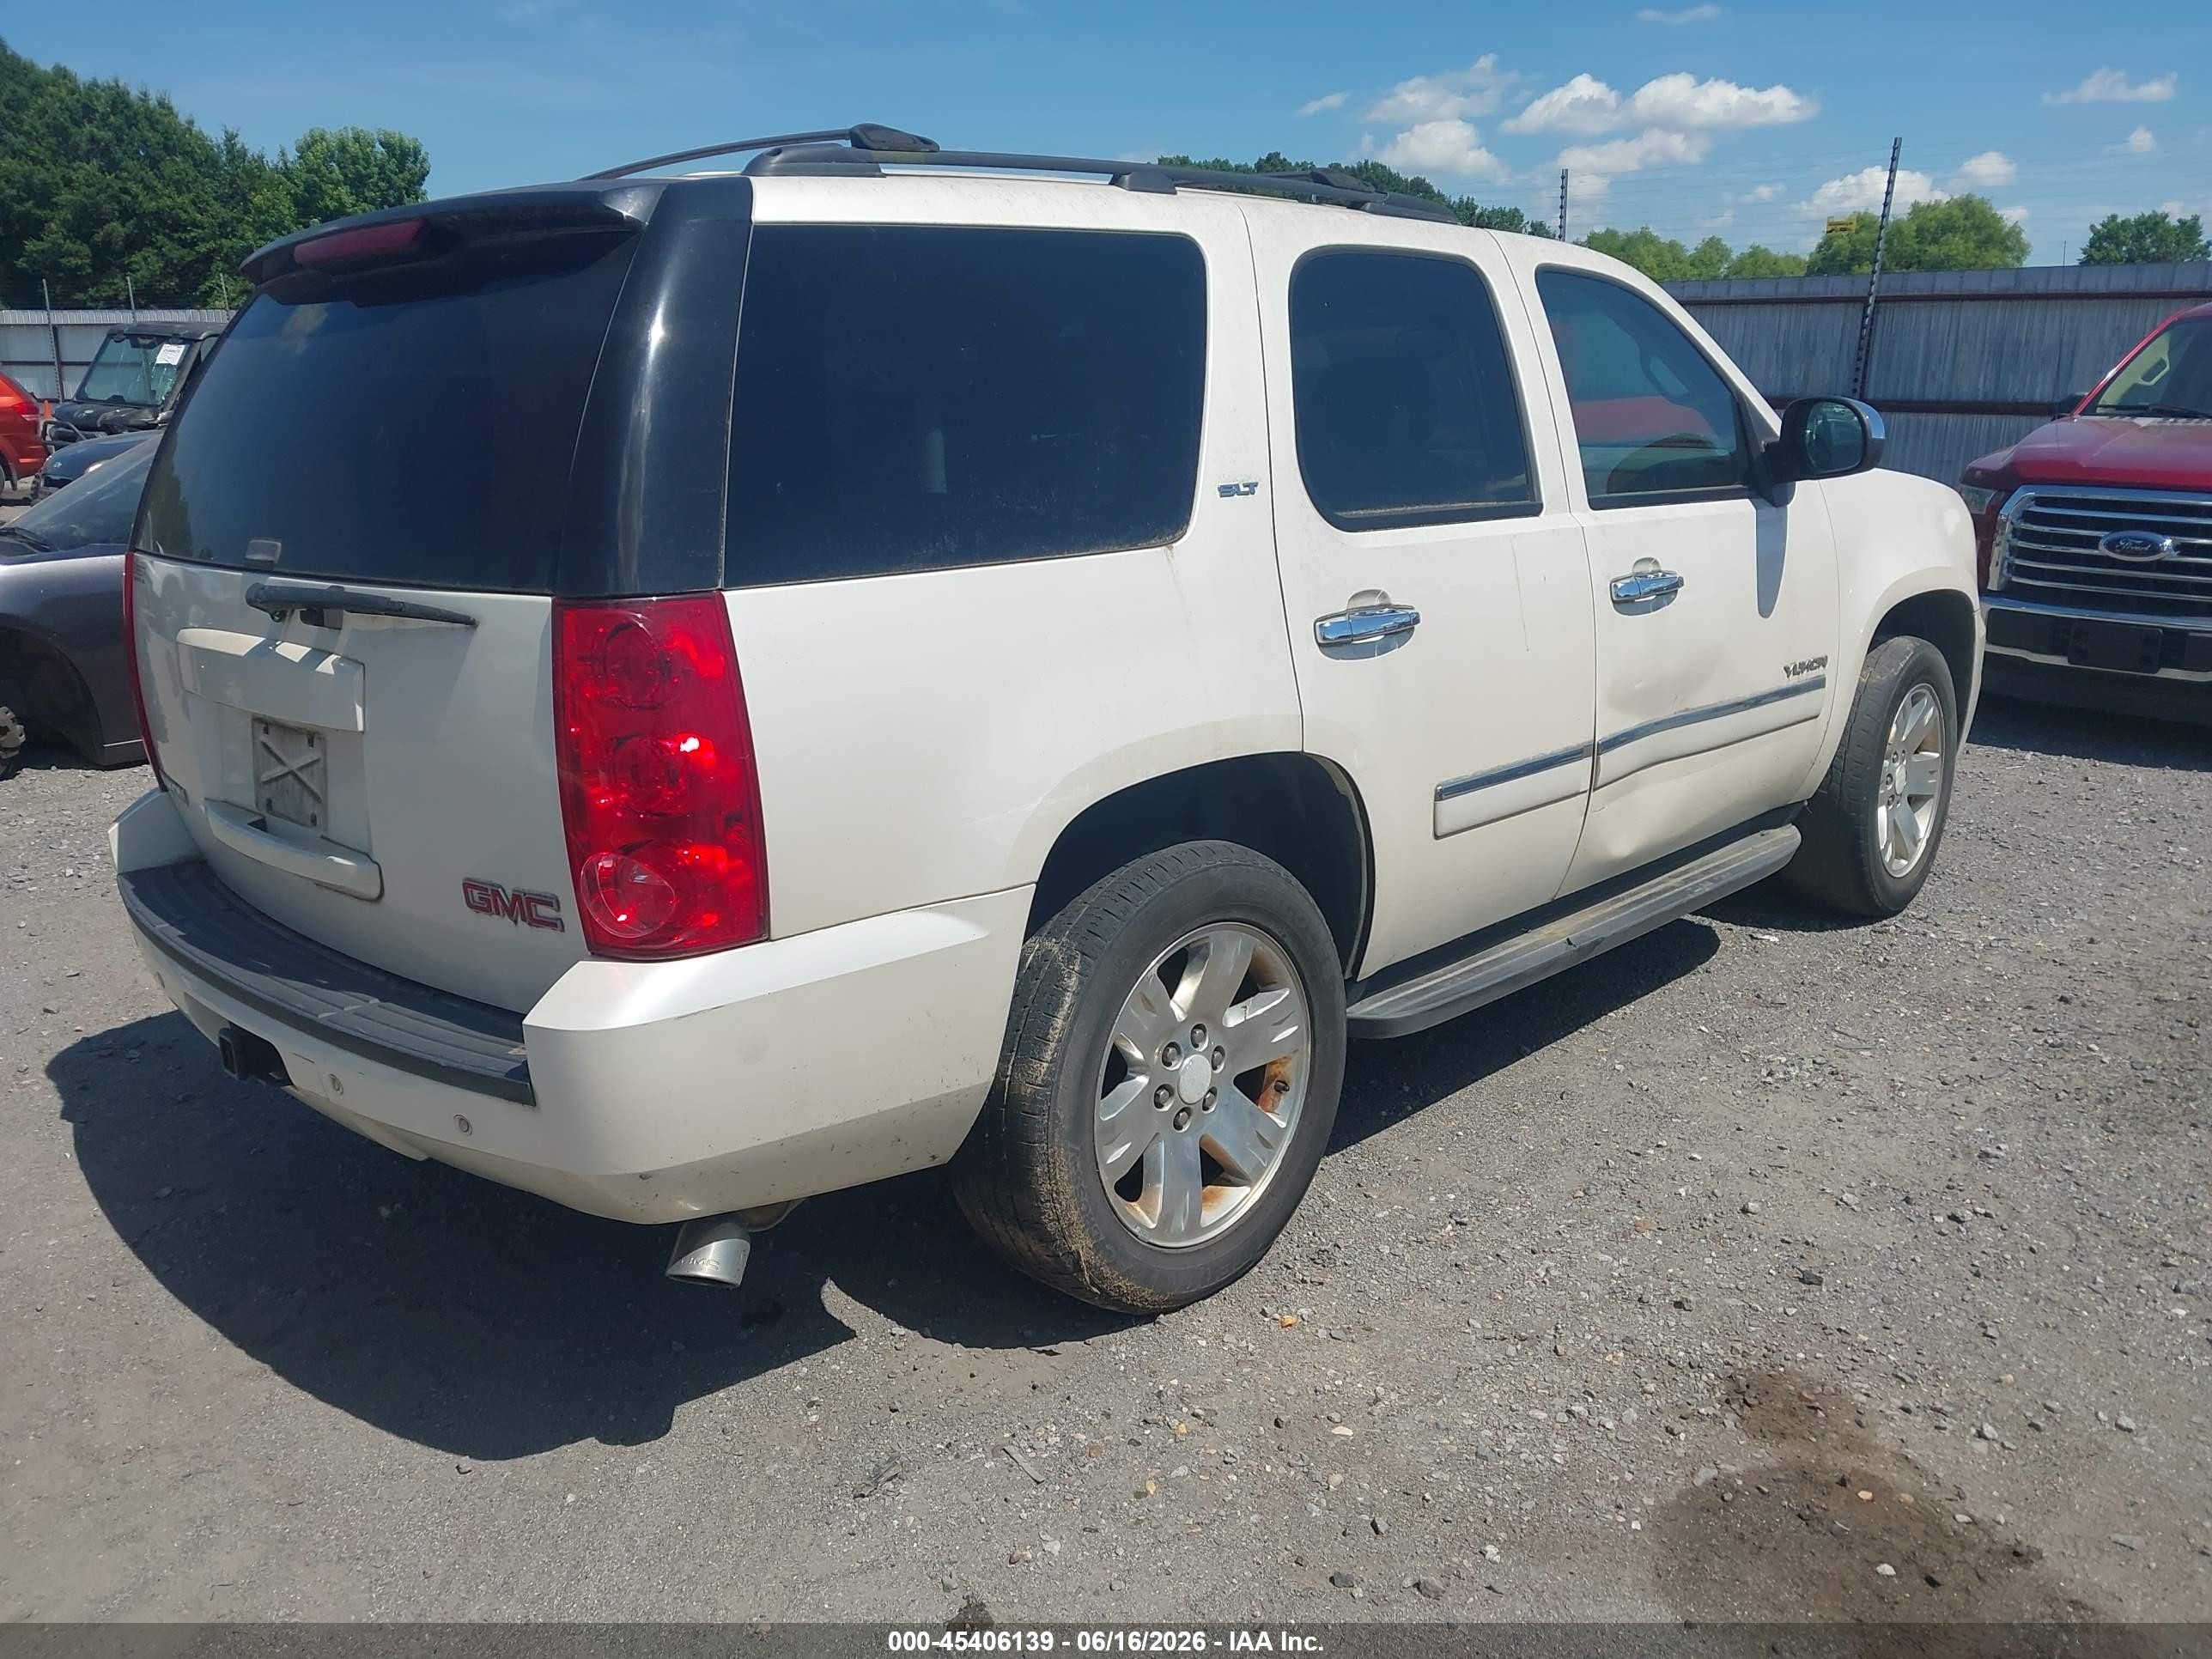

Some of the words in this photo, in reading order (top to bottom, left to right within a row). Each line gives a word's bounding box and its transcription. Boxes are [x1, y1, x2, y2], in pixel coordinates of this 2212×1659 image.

[1217, 481, 1259, 498] SLT
[2116, 538, 2152, 551] Ford
[1783, 655, 1828, 678] YUKON
[462, 878, 565, 933] GMC
